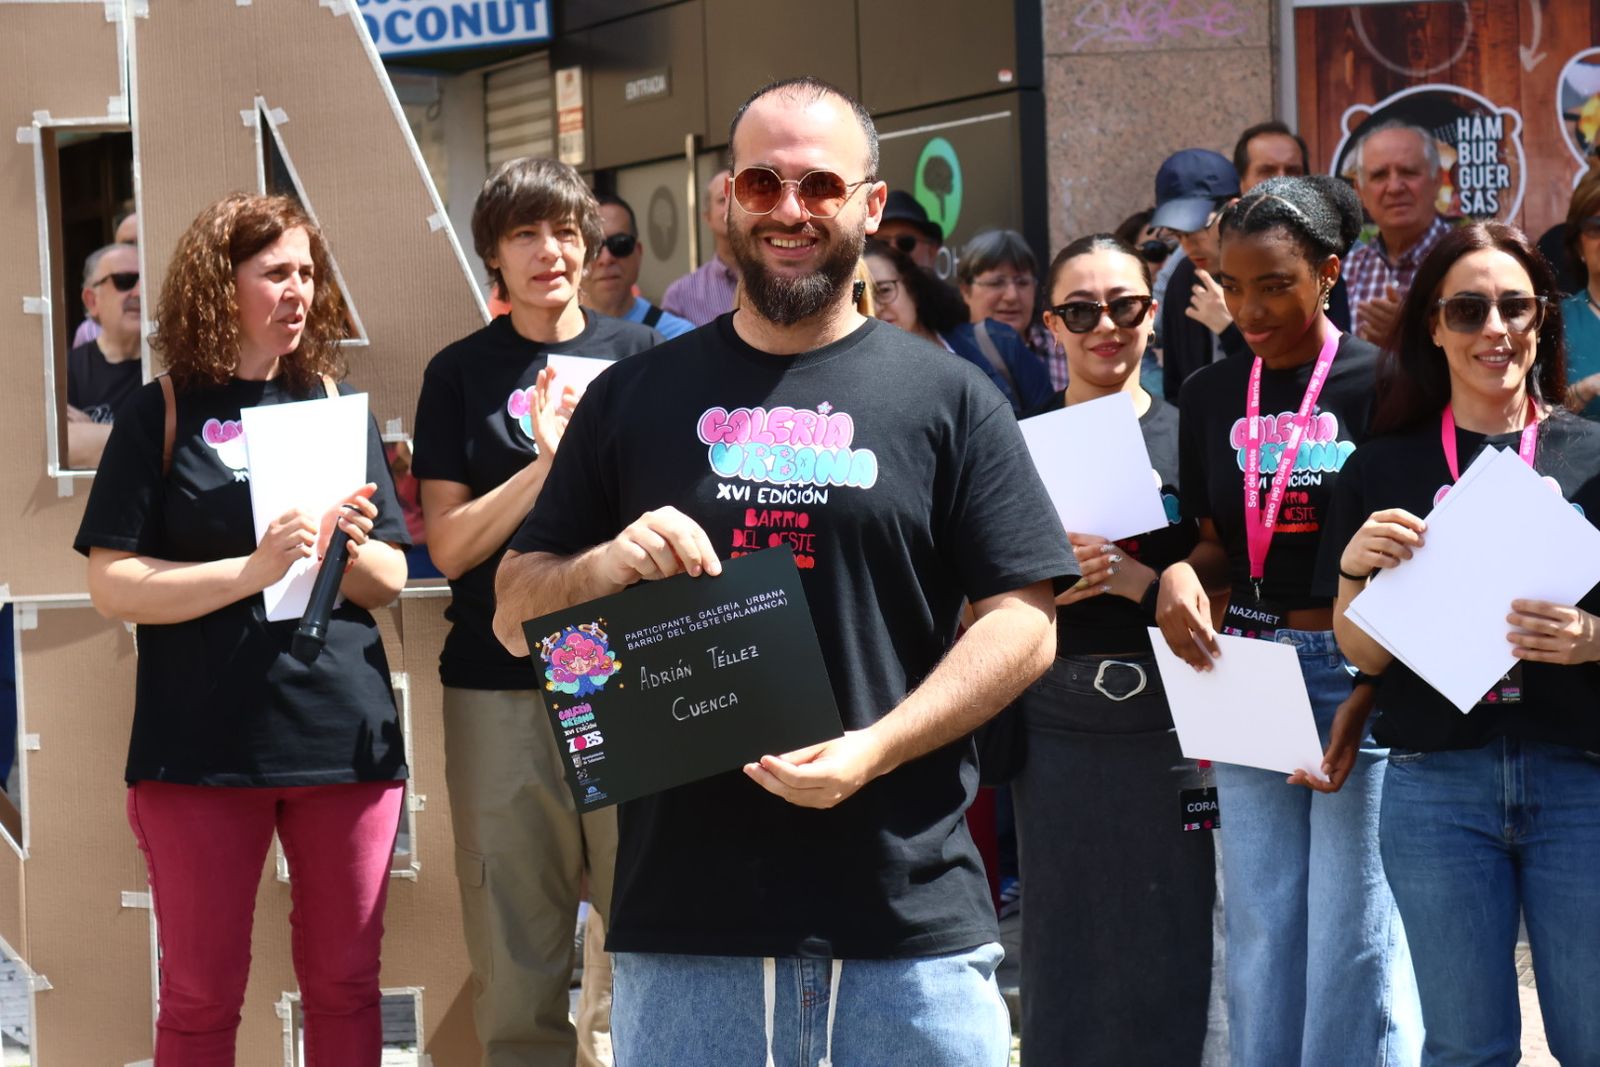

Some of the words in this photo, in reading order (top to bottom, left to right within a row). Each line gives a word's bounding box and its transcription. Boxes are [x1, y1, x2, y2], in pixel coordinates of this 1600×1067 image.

[1458, 141, 1498, 165] BUR
[1459, 165, 1509, 189] GUER
[1460, 189, 1499, 214] SAS
[708, 442, 878, 489] URBANA
[1249, 448, 1257, 472] oeste
[1275, 458, 1291, 485] Barrio
[716, 482, 751, 501] XVI
[757, 483, 828, 504] EDICIÓN
[1249, 474, 1257, 489] del
[1248, 490, 1258, 508] Soy
[1270, 486, 1281, 502] del
[745, 507, 809, 529] BARRIO
[1265, 502, 1276, 528] oeste
[731, 528, 762, 549] DEL
[768, 531, 816, 552] OESTE
[624, 615, 692, 642] PARTICIPANTE
[698, 601, 740, 619] GALERÍA
[746, 588, 785, 606] URBANA
[627, 633, 663, 650] BARRIO
[667, 627, 685, 639] DEL
[689, 617, 721, 632] OESTE
[723, 597, 788, 624] (SALAMANCA)
[1229, 604, 1280, 625] NAZARET
[706, 645, 760, 669] TÉLLEZ
[672, 692, 739, 721] CUENCA
